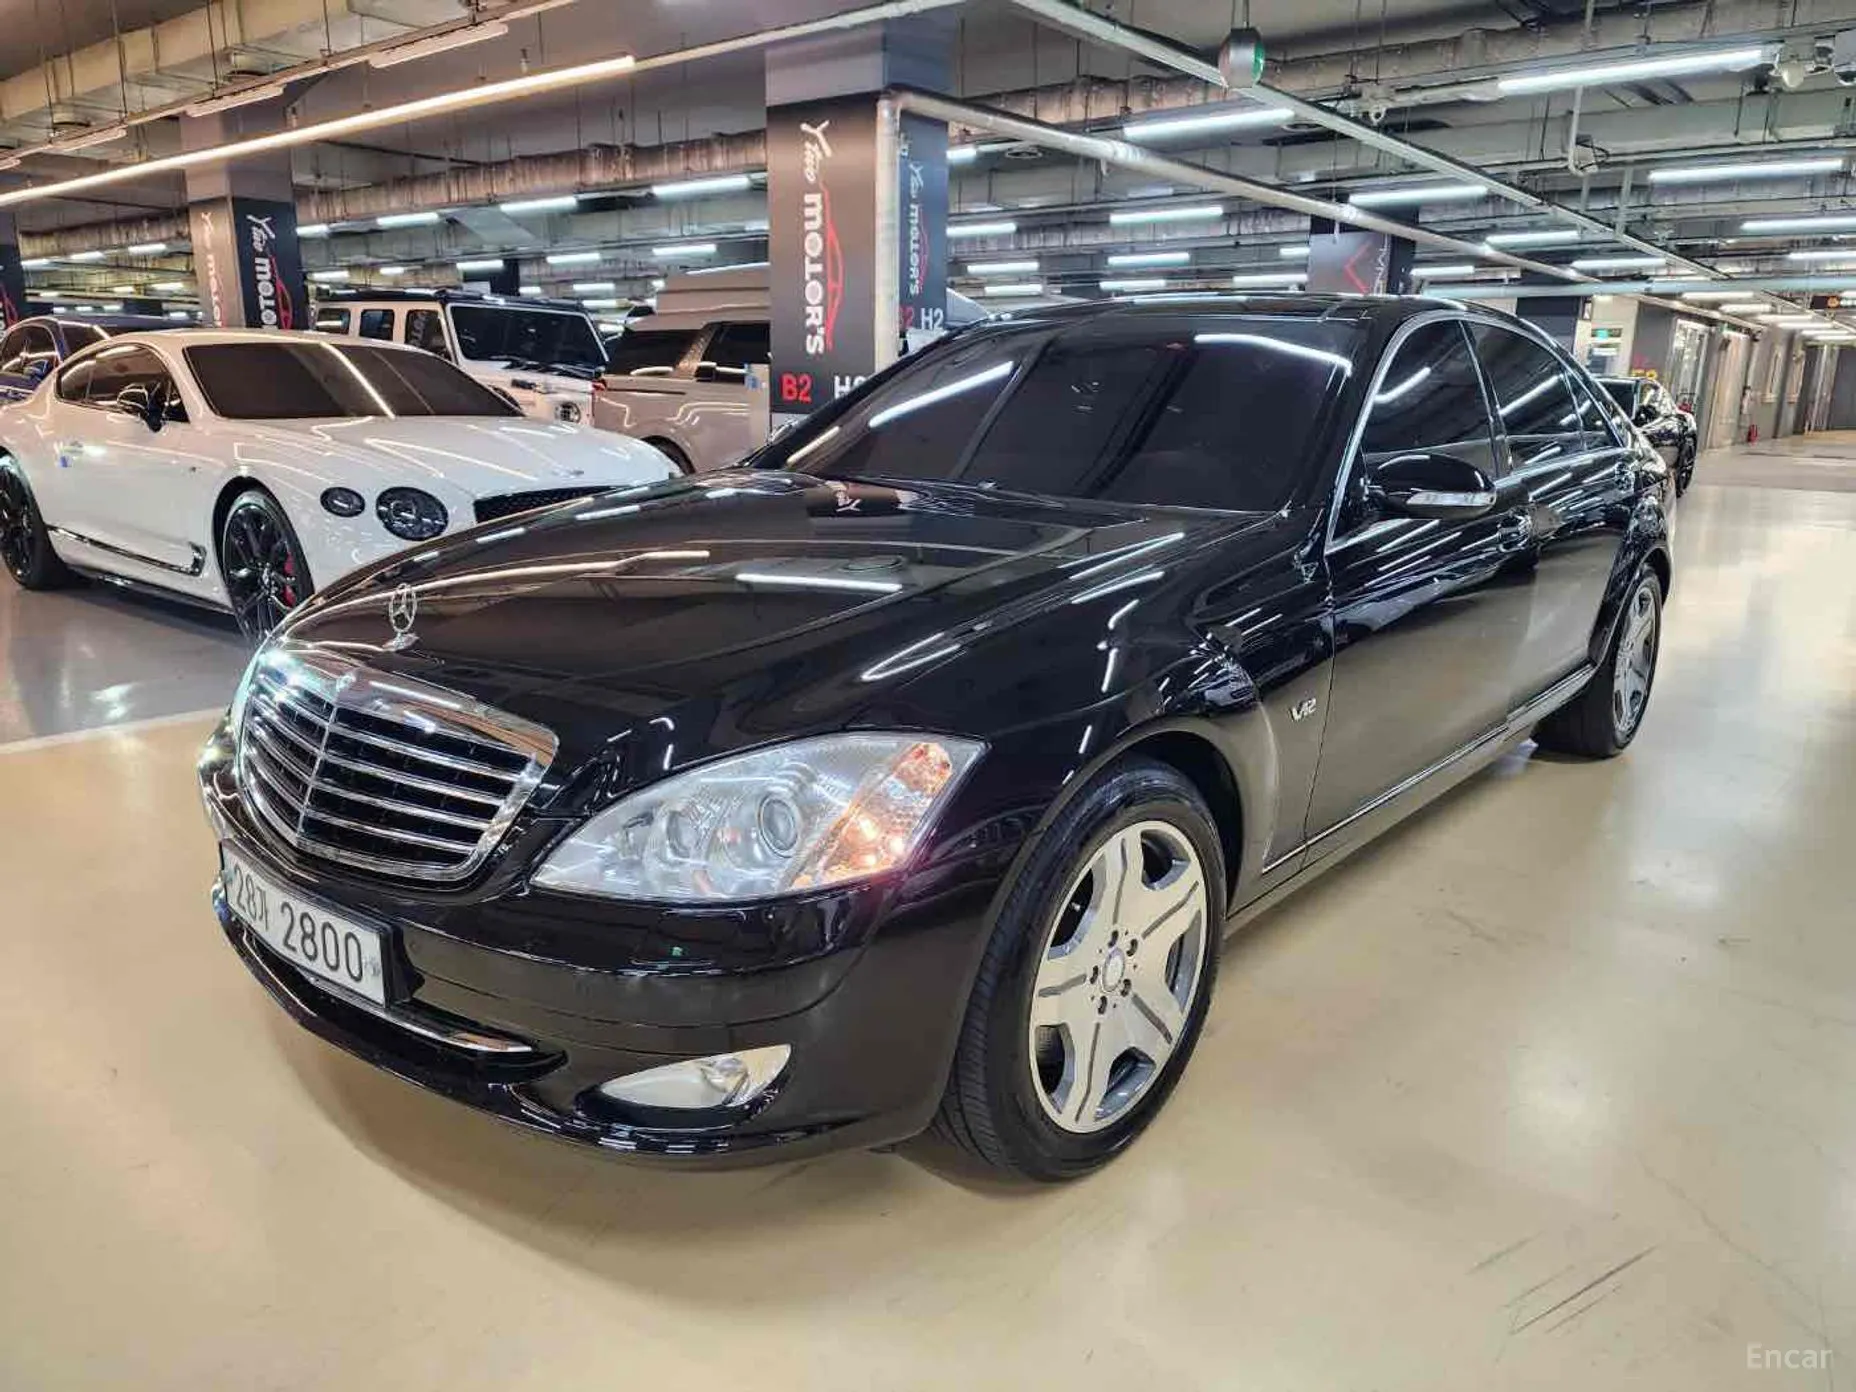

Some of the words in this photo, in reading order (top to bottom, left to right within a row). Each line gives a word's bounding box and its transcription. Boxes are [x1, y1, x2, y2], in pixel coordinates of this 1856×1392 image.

[920, 307, 945, 330] H2
[780, 371, 813, 405] B2
[280, 901, 364, 983] 2800
